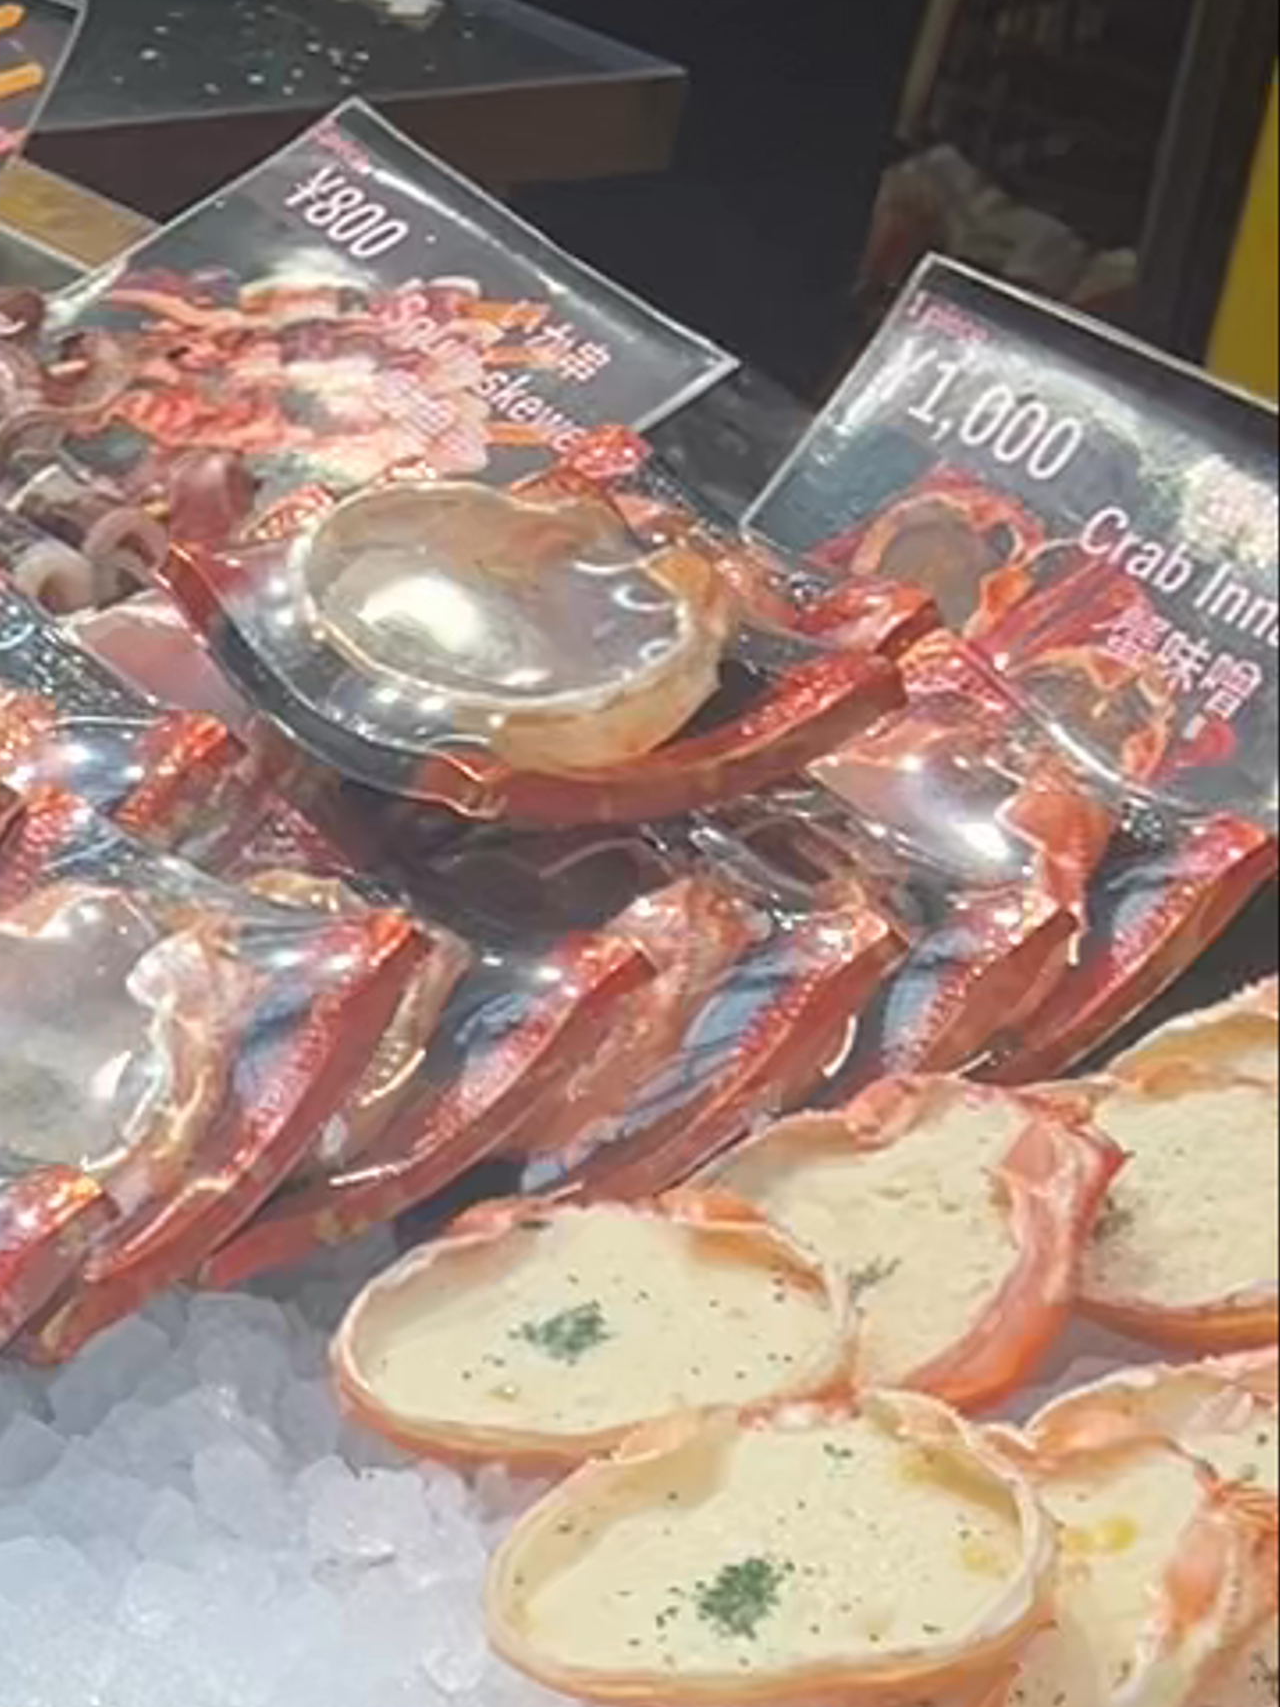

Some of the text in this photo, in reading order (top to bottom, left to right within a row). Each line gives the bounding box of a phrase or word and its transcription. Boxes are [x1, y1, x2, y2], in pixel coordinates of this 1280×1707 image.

[285, 166, 409, 258] ¥800
[873, 336, 1083, 480] ¥1,000
[1079, 506, 1194, 594] Crab
